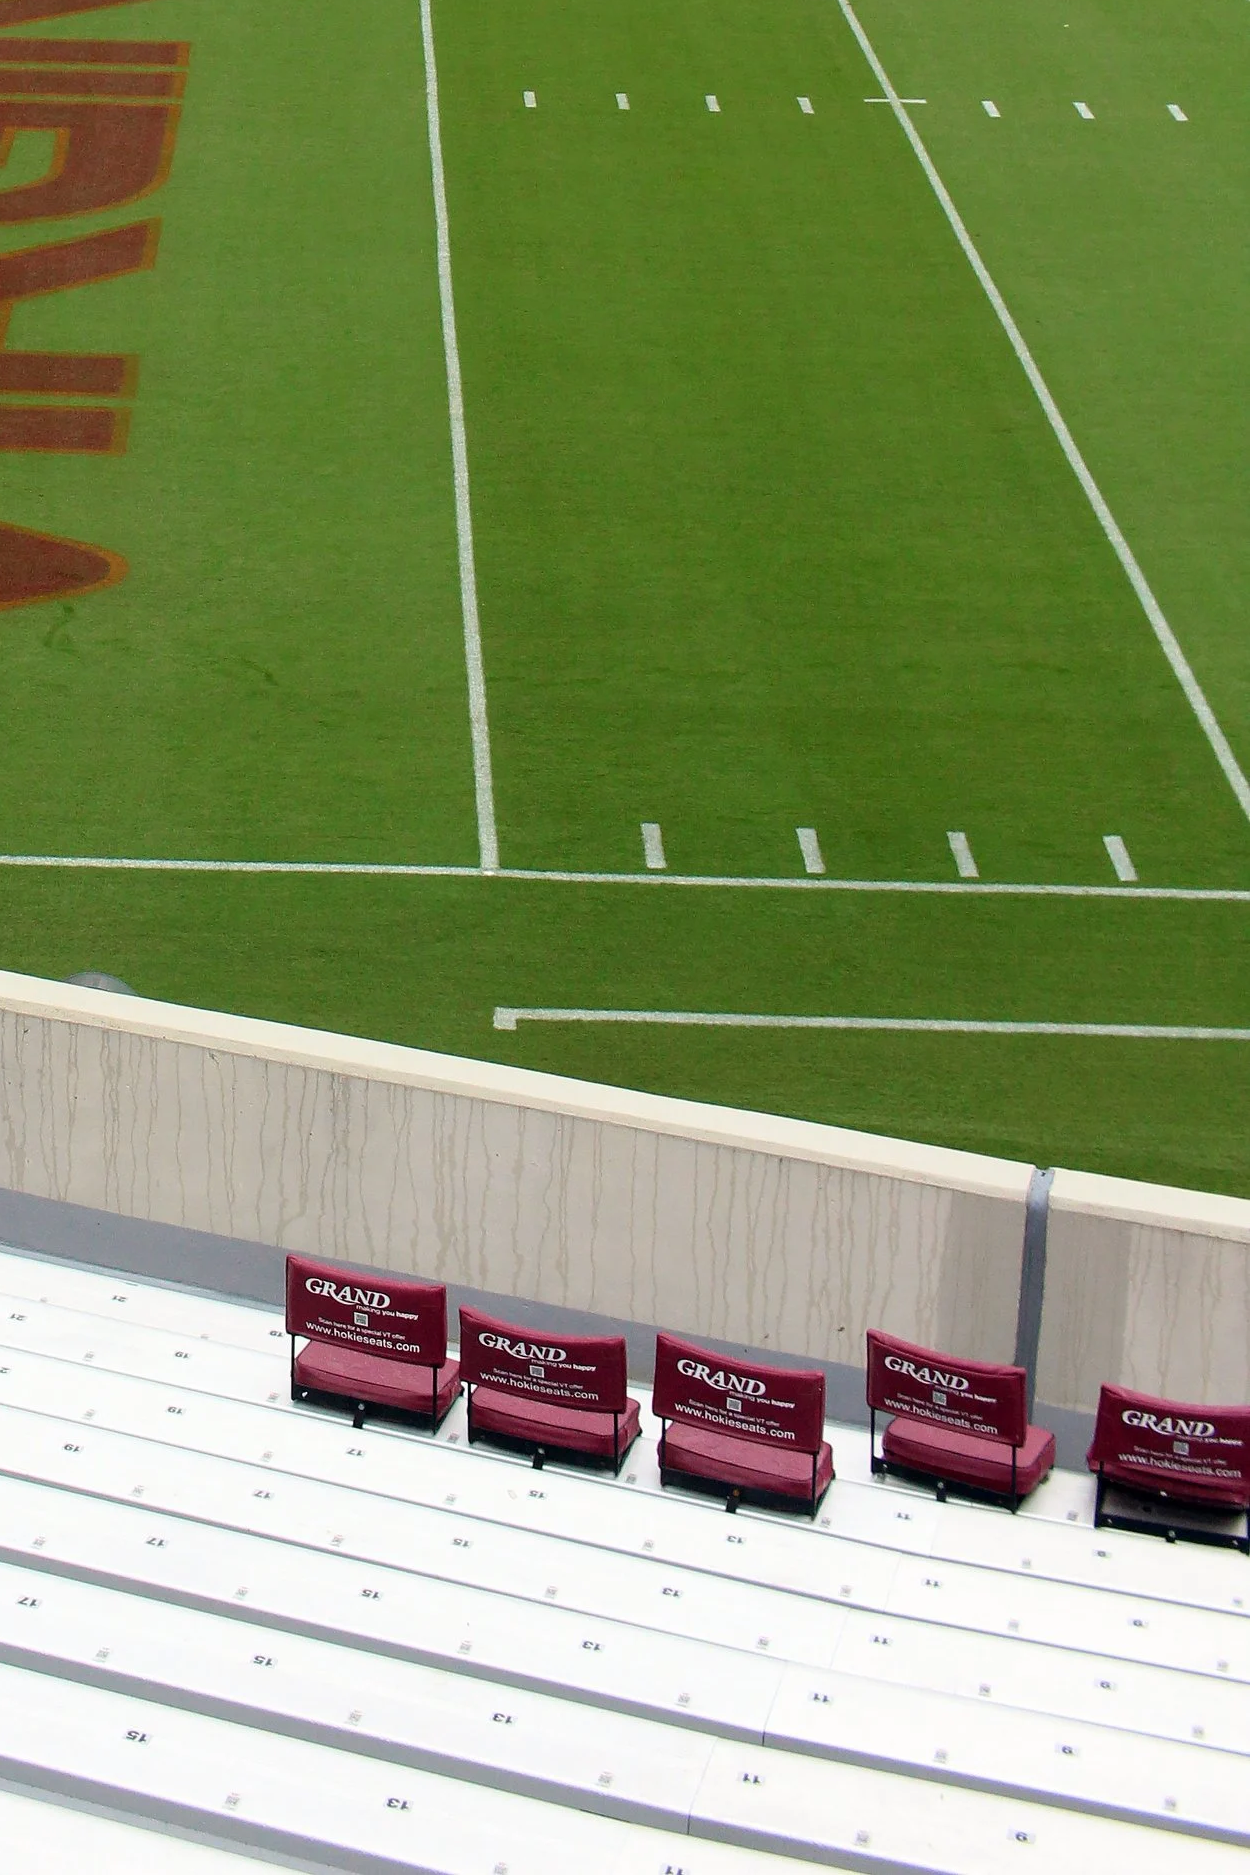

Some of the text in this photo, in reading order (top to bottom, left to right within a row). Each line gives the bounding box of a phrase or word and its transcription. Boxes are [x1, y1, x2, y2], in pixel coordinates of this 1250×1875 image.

[305, 1277, 390, 1308] GRAND
[382, 1309, 395, 1317] you
[396, 1311, 419, 1320] happy
[305, 1321, 420, 1353] www.hokieseats.com
[478, 1332, 567, 1362] GRAND
[573, 1363, 596, 1372] happy
[884, 1356, 969, 1390] GRAND
[677, 1359, 766, 1396] GRAND
[479, 1371, 599, 1400] www.hokieseats.com
[756, 1396, 770, 1405] you
[771, 1399, 795, 1409] happy
[674, 1403, 796, 1440] www.hokieseats.com
[883, 1397, 998, 1435] www.hokieseats.com
[1121, 1410, 1215, 1437] GRAND
[63, 1443, 80, 1453] 19
[346, 1448, 363, 1457] 17
[253, 1490, 271, 1499] 17
[528, 1490, 545, 1499] 15
[145, 1537, 165, 1547] 17
[453, 1538, 469, 1548] 15
[726, 1535, 743, 1544] 13
[361, 1588, 380, 1600] 15
[661, 1587, 680, 1598] 13
[17, 1596, 37, 1607] 17
[581, 1640, 601, 1651] 13
[253, 1655, 273, 1667] 15
[813, 1692, 830, 1704] 11
[492, 1712, 513, 1725] 13
[125, 1730, 147, 1743] 15
[742, 1772, 761, 1785] 11
[386, 1797, 409, 1811] 13
